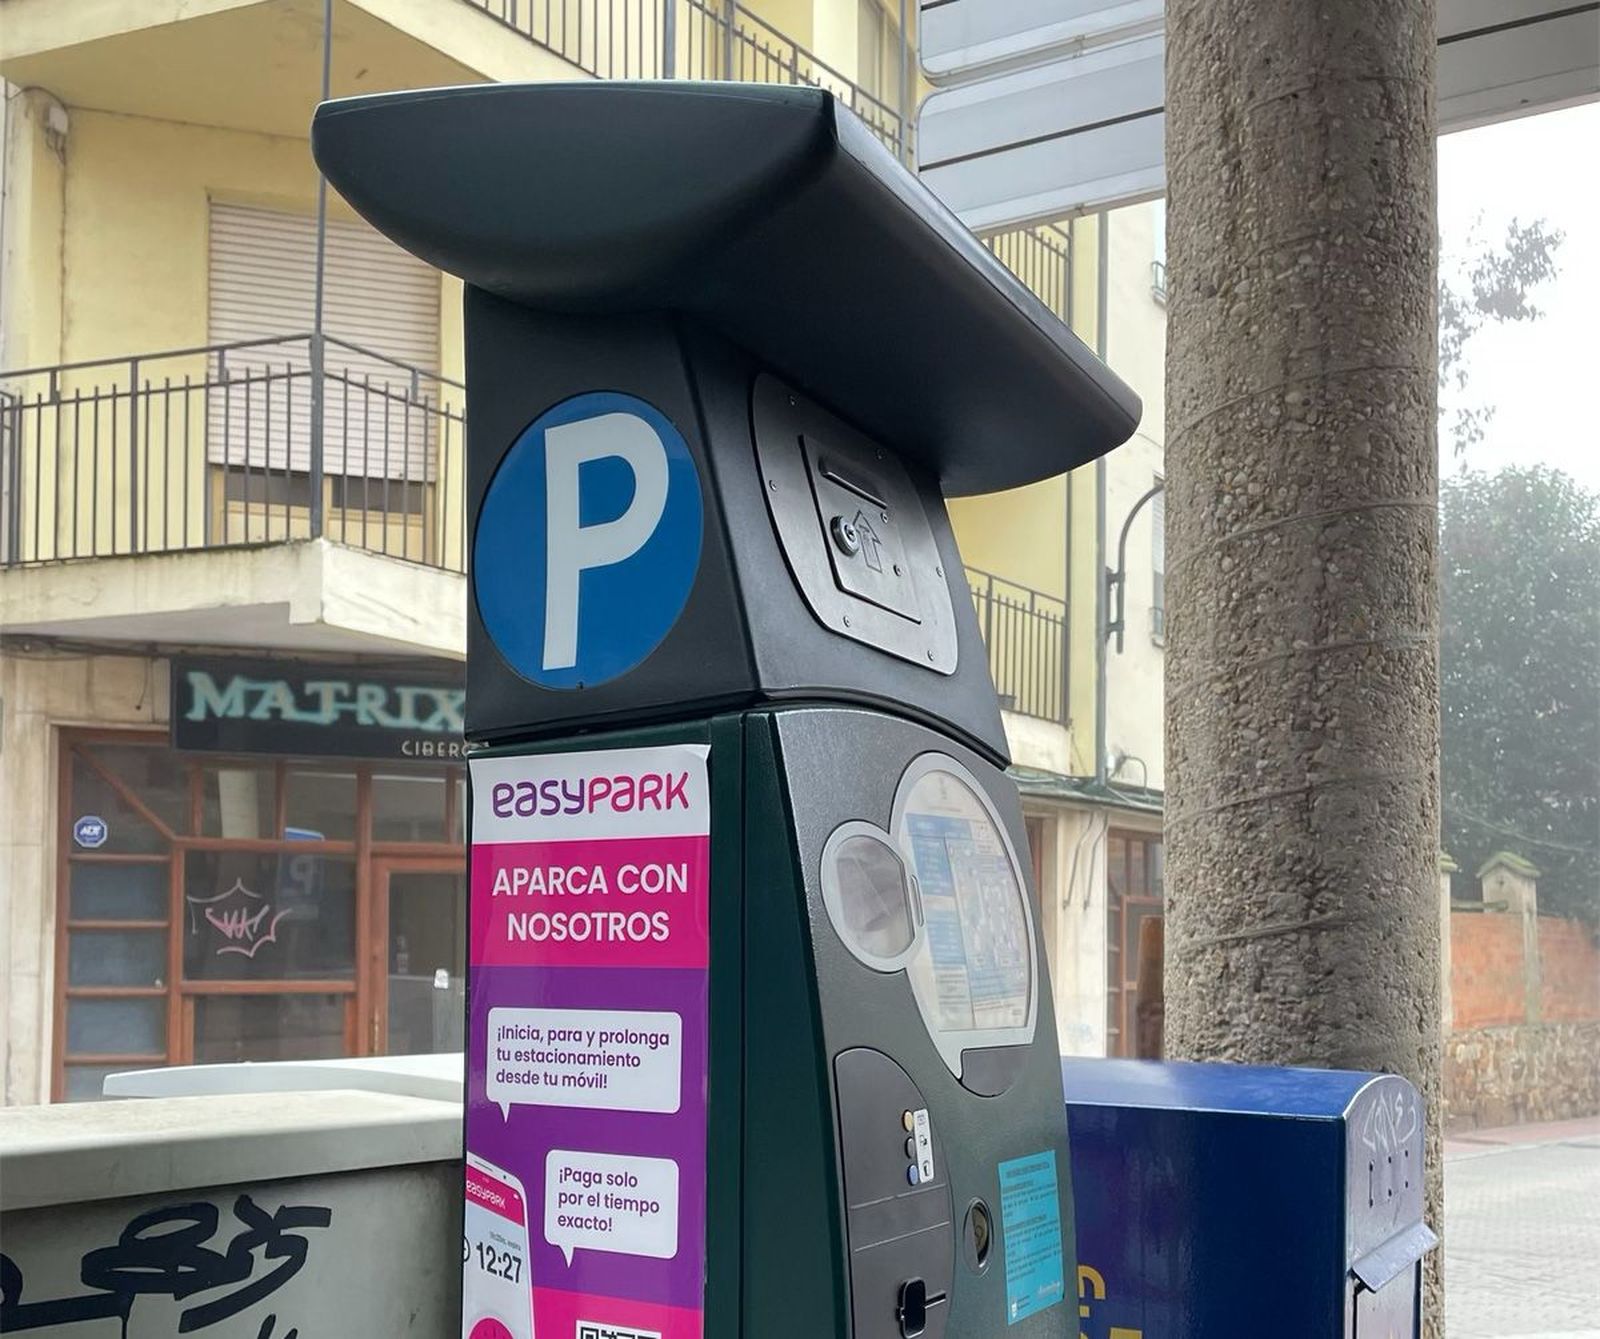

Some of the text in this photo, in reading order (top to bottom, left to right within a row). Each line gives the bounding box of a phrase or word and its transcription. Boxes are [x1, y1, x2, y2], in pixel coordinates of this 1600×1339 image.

[542, 412, 669, 670] P
[185, 671, 466, 732] MATRIX
[492, 863, 688, 896] APARCA CON
[507, 911, 670, 941] NOSOTROS
[497, 1025, 670, 1049] ¡Inicia, para y prolonga
[496, 1049, 641, 1068] tu estacionamiento
[496, 1069, 608, 1089] desde tu móvil!
[559, 1168, 638, 1188] ¡Paga solo
[558, 1192, 660, 1216] por el tiempo
[557, 1214, 613, 1232] exacto!
[475, 1240, 522, 1284] 12:27
